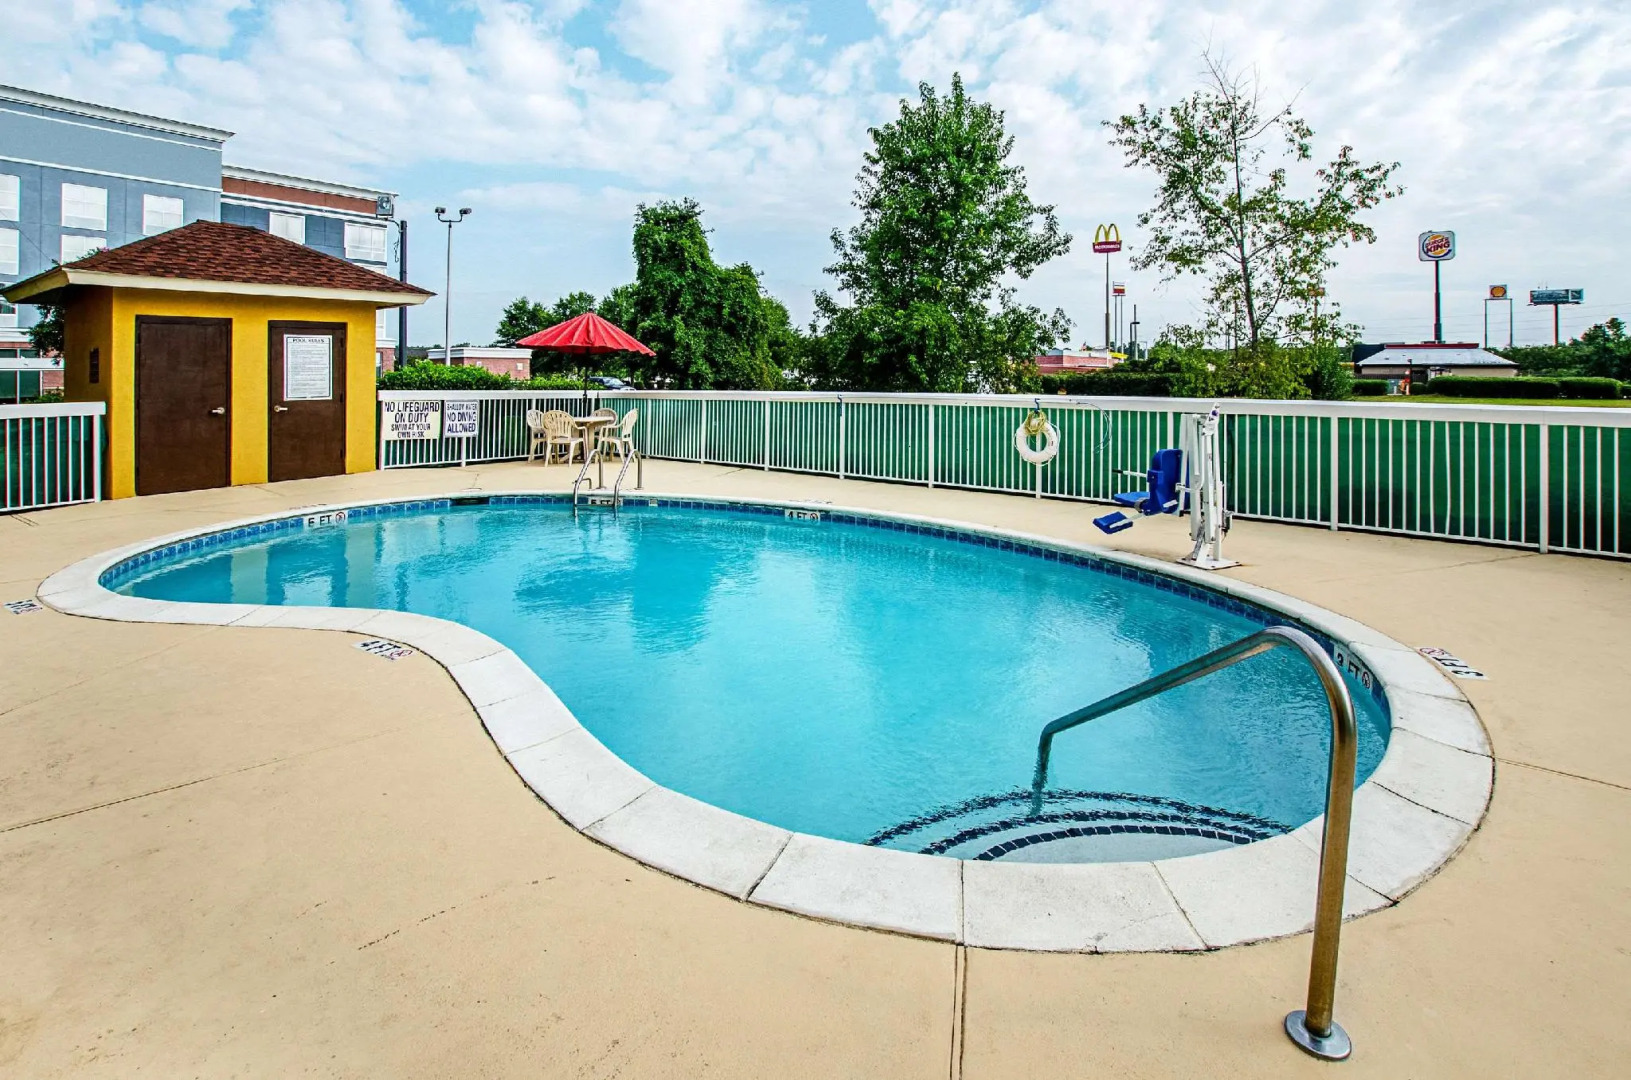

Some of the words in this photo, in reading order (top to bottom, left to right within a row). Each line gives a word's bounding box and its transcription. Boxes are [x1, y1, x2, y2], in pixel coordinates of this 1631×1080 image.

[1426, 241, 1450, 253] KING
[385, 402, 395, 412] NO
[397, 401, 440, 412] LIFEGUARD
[394, 412, 406, 423] ON
[408, 412, 429, 423] DUTY
[447, 412, 456, 422] NO
[457, 411, 476, 422] DIVING
[447, 423, 476, 433] ALLOWED
[1347, 660, 1360, 680] FT
